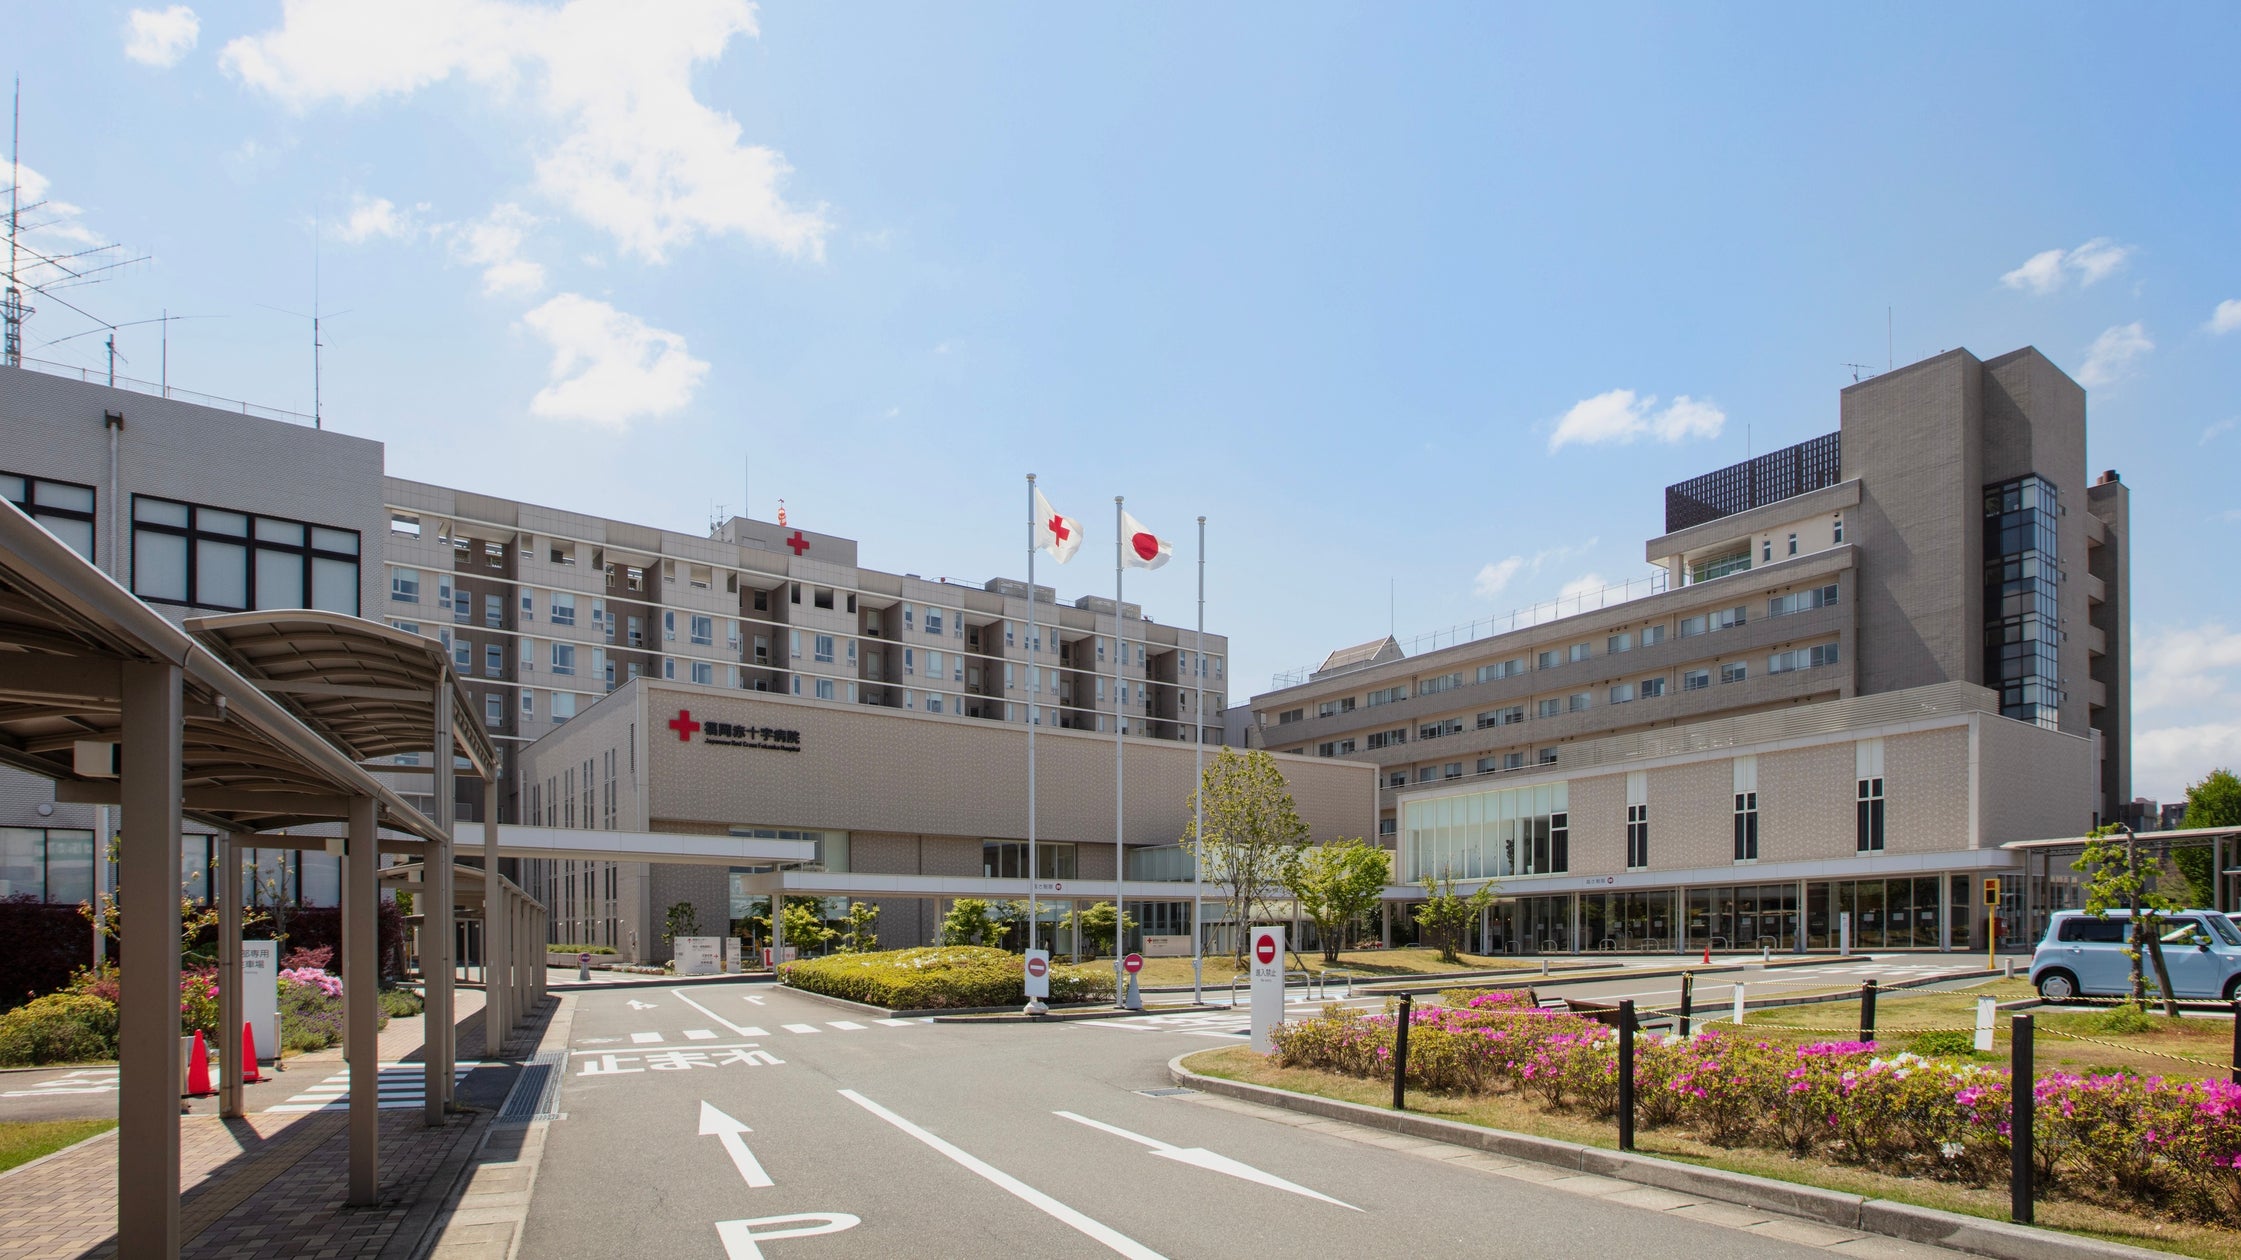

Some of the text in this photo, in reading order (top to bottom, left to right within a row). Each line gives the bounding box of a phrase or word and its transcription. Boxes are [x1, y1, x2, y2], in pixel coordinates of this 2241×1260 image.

[704, 721, 800, 744] 福岡赤十字病院
[704, 738, 731, 746] Japanese
[241, 960, 265, 968] 車場
[1255, 968, 1277, 977] 進入禁止
[576, 1048, 786, 1076] 止まれ
[714, 1211, 862, 1260] P
